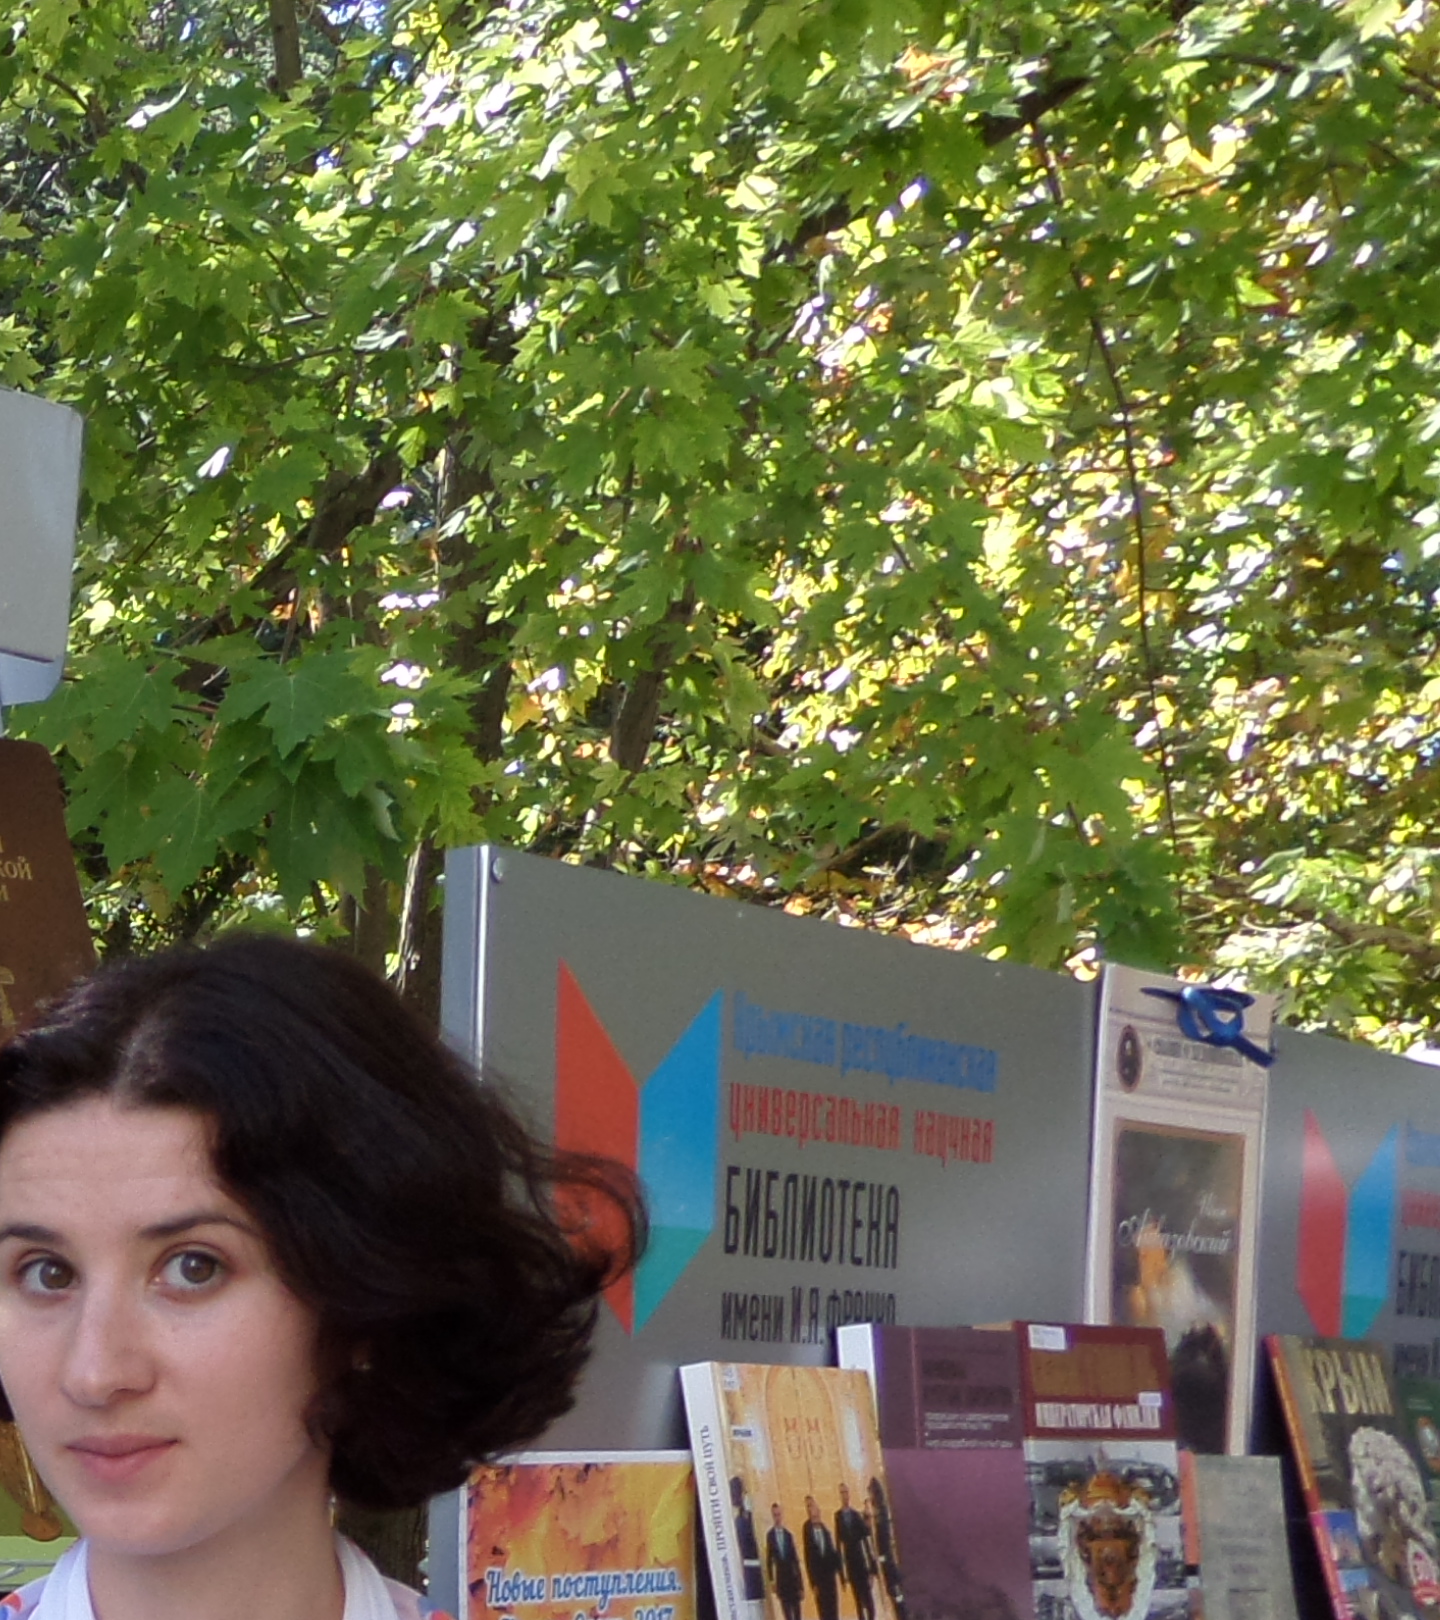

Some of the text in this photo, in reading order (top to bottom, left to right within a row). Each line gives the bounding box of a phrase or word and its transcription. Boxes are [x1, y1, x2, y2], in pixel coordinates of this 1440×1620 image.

[723, 1165, 900, 1269] БИБЛИОТЕКА
[721, 1291, 784, 1342] имени
[484, 1567, 683, 1610] Новые поступления.
